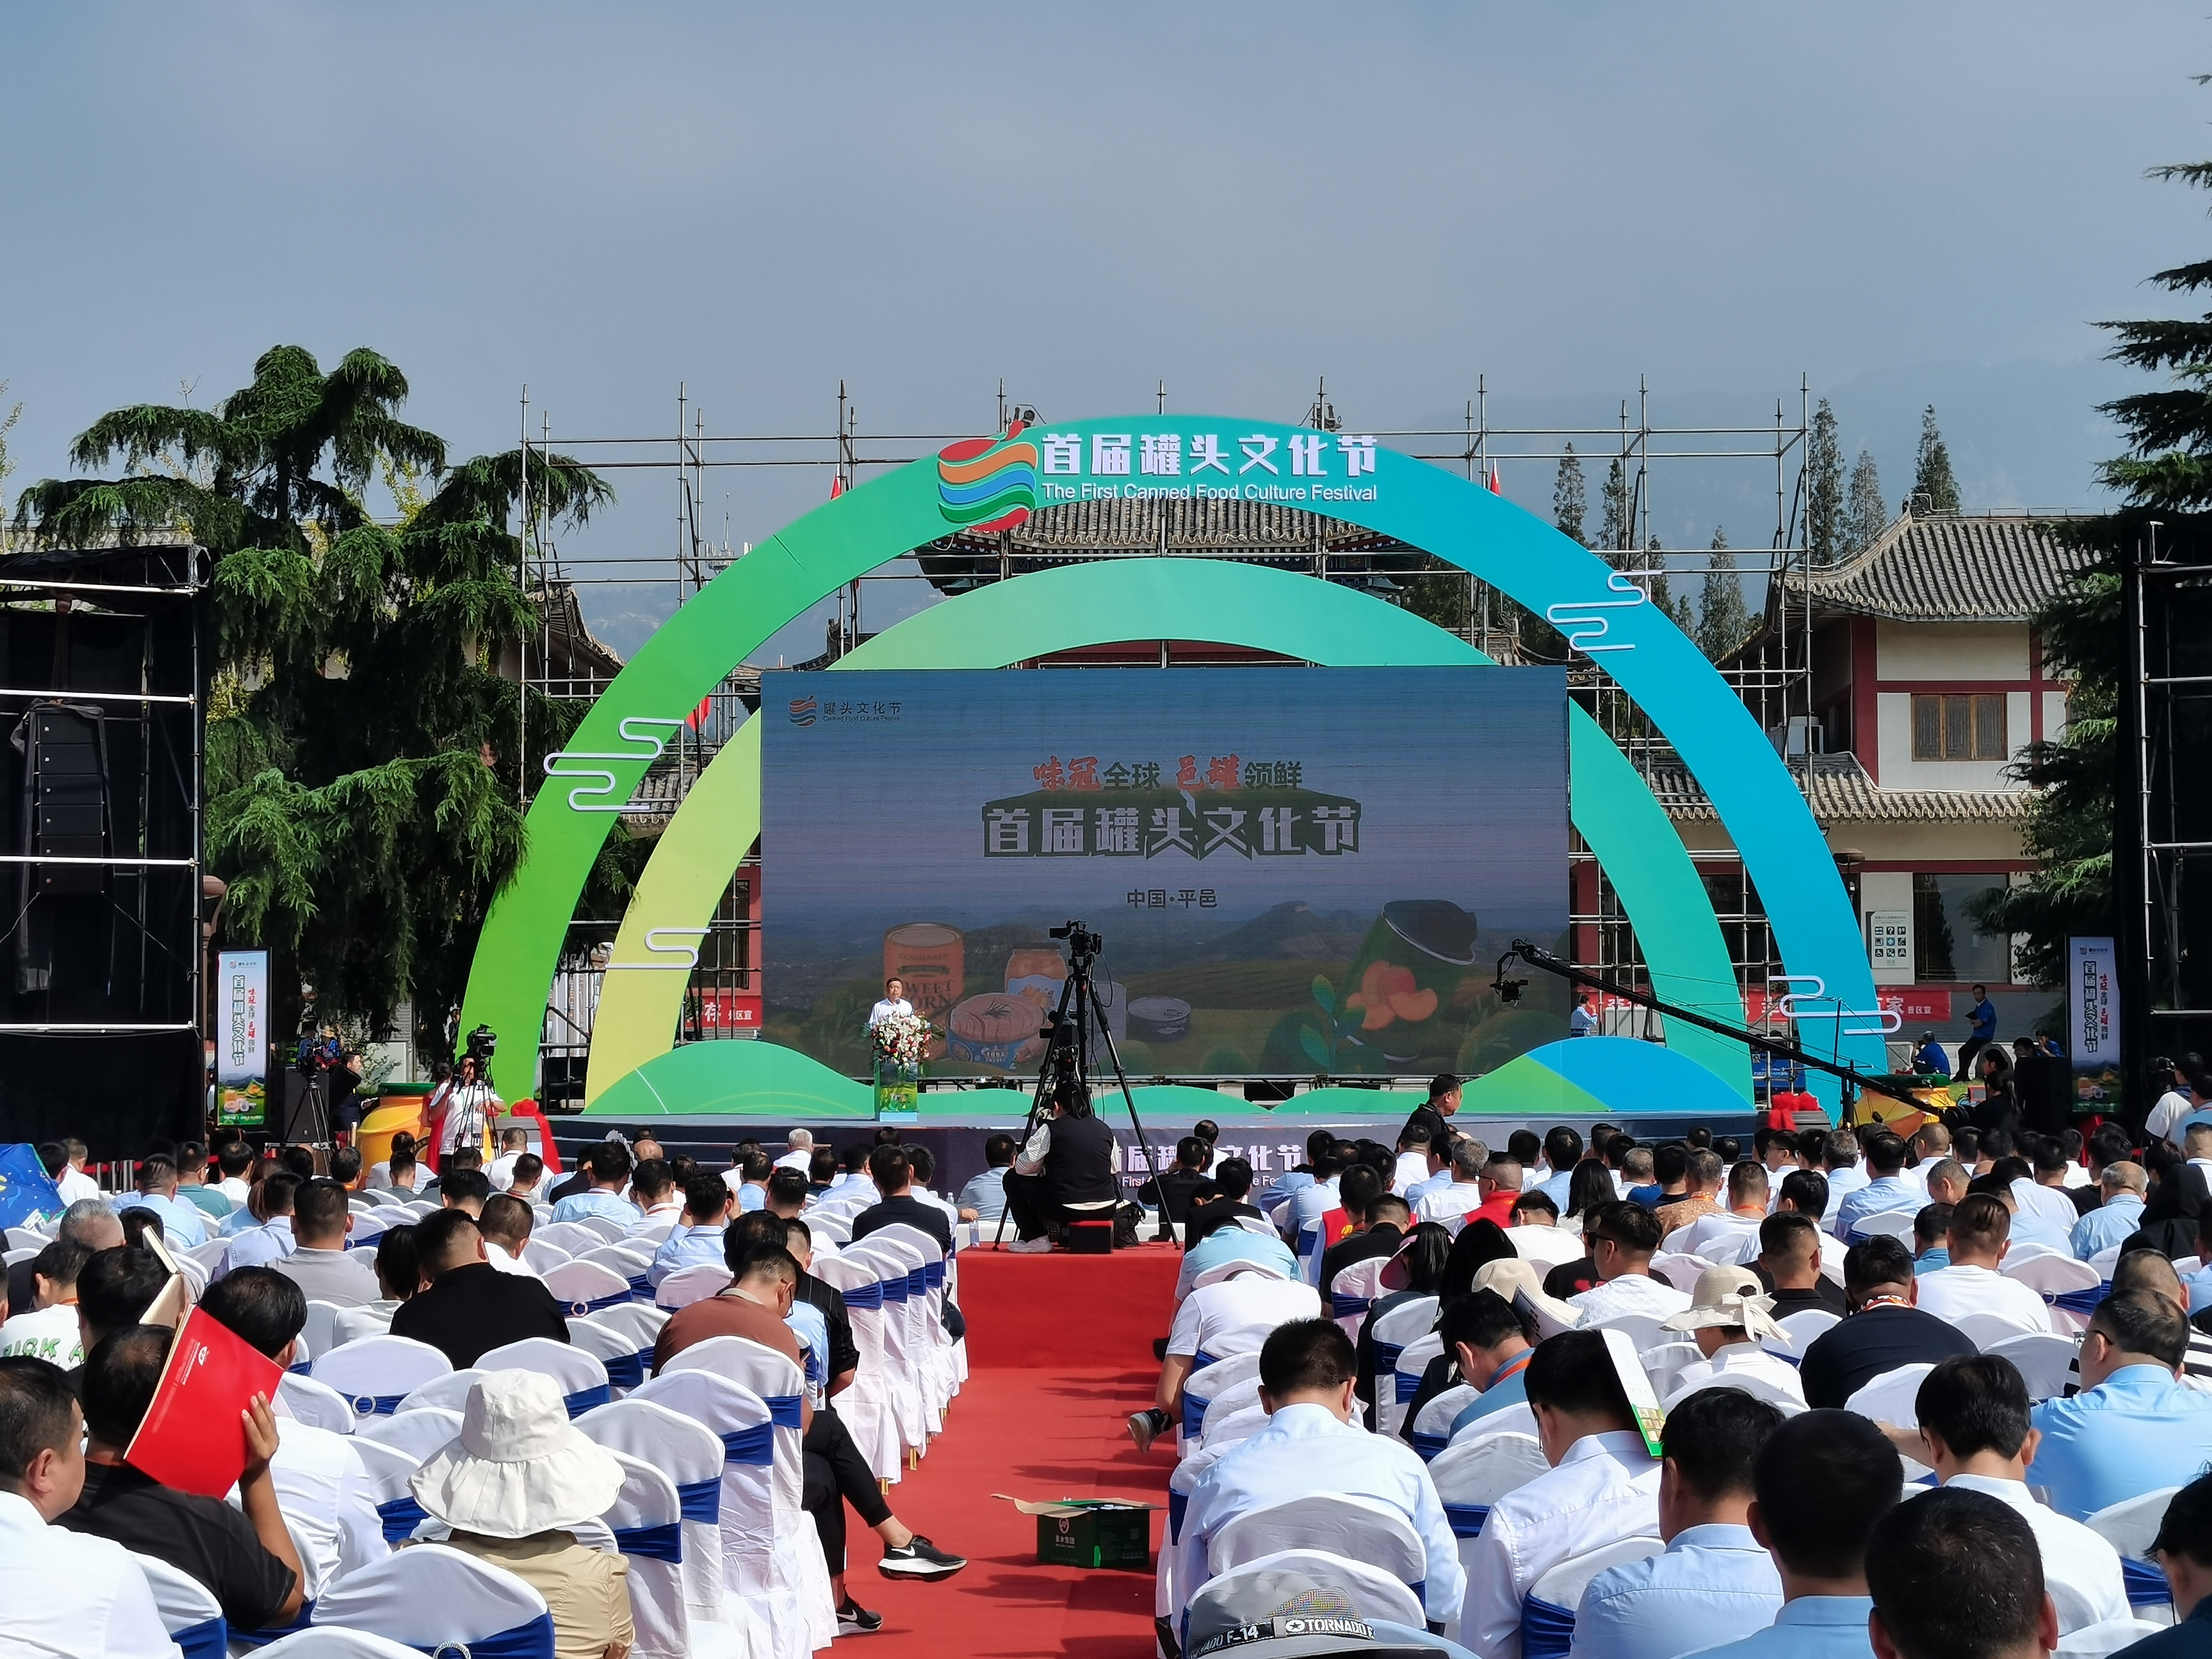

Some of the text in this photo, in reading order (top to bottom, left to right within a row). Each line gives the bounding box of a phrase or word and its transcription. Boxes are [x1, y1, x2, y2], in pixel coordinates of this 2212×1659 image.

[1042, 433, 1377, 476] 首届罐头文化节
[1042, 483, 1377, 501] The First Canned Food Culture Festival
[823, 701, 902, 715] 罐头文化节
[1033, 754, 1303, 791] 味冠全球 邑罐领鲜
[987, 806, 1358, 853] 首届罐头文化节
[904, 980, 954, 994] WEET
[1227, 1625, 1259, 1644] F-14
[1304, 1619, 1368, 1635] TORNADO
